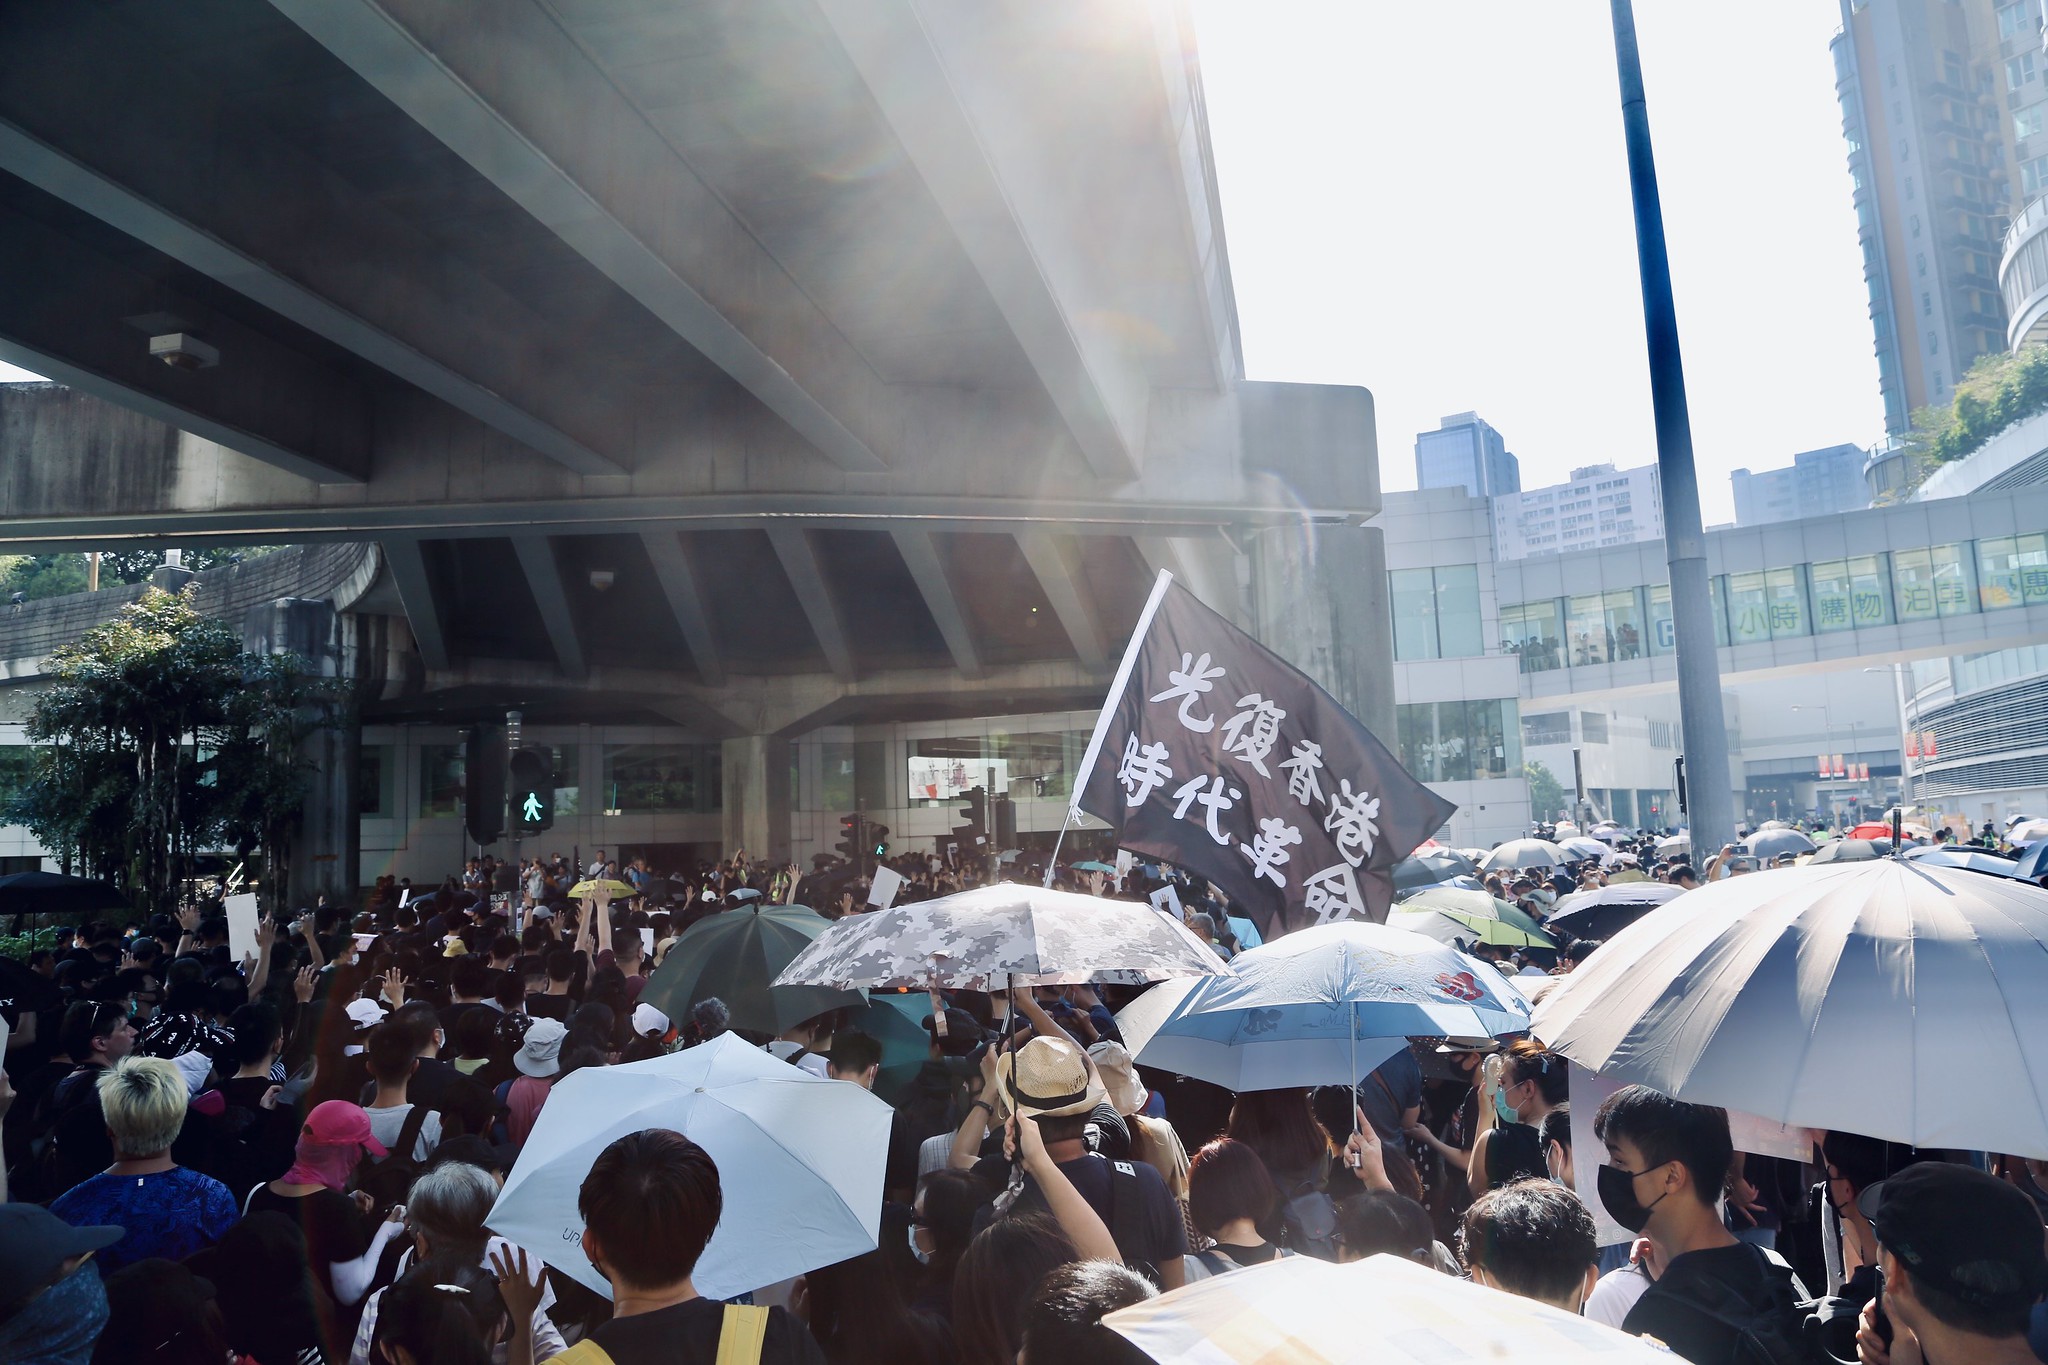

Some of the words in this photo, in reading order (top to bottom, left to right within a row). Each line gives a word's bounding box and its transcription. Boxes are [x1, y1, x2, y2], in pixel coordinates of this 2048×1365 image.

[1116, 730, 1366, 925] 時代革命
[1149, 652, 1381, 868] 光復香港
